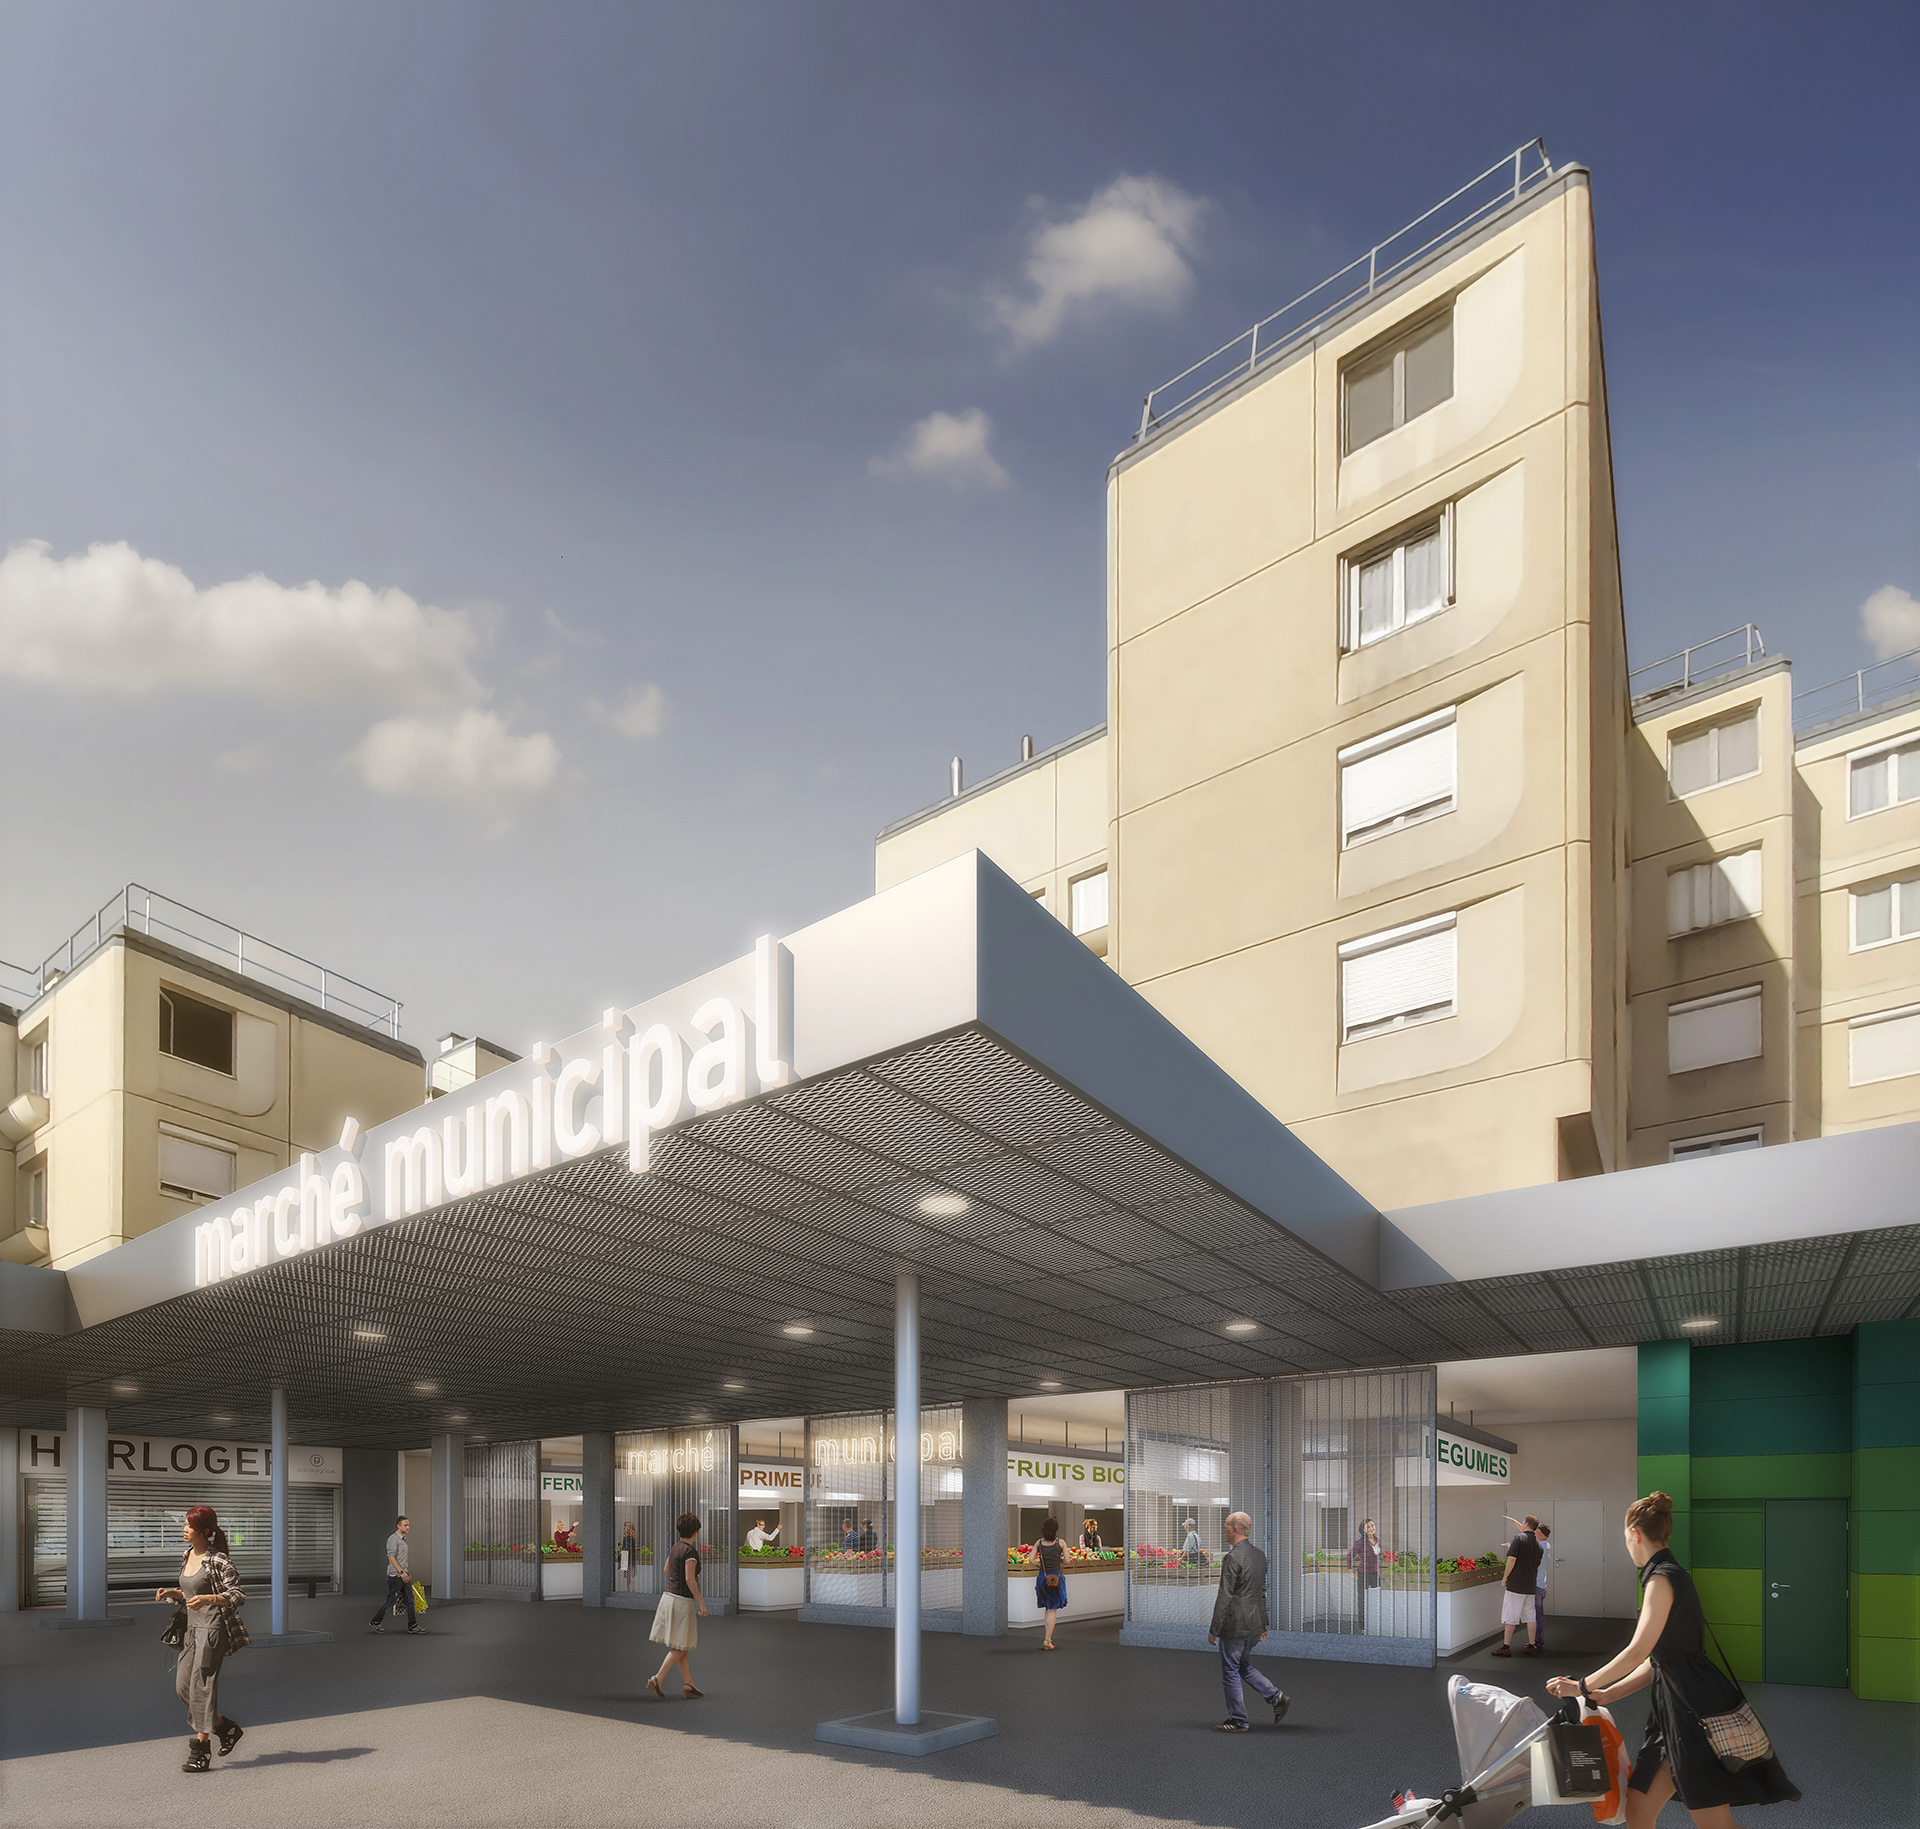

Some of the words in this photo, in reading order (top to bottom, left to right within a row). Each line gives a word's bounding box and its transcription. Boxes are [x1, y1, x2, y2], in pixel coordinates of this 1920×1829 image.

[194, 1116, 365, 1287] marché
[385, 934, 789, 1220] municipal
[30, 1434, 272, 1476] HRLOGE
[627, 1431, 714, 1475] marché
[1425, 1435, 1508, 1478] LEGUMES
